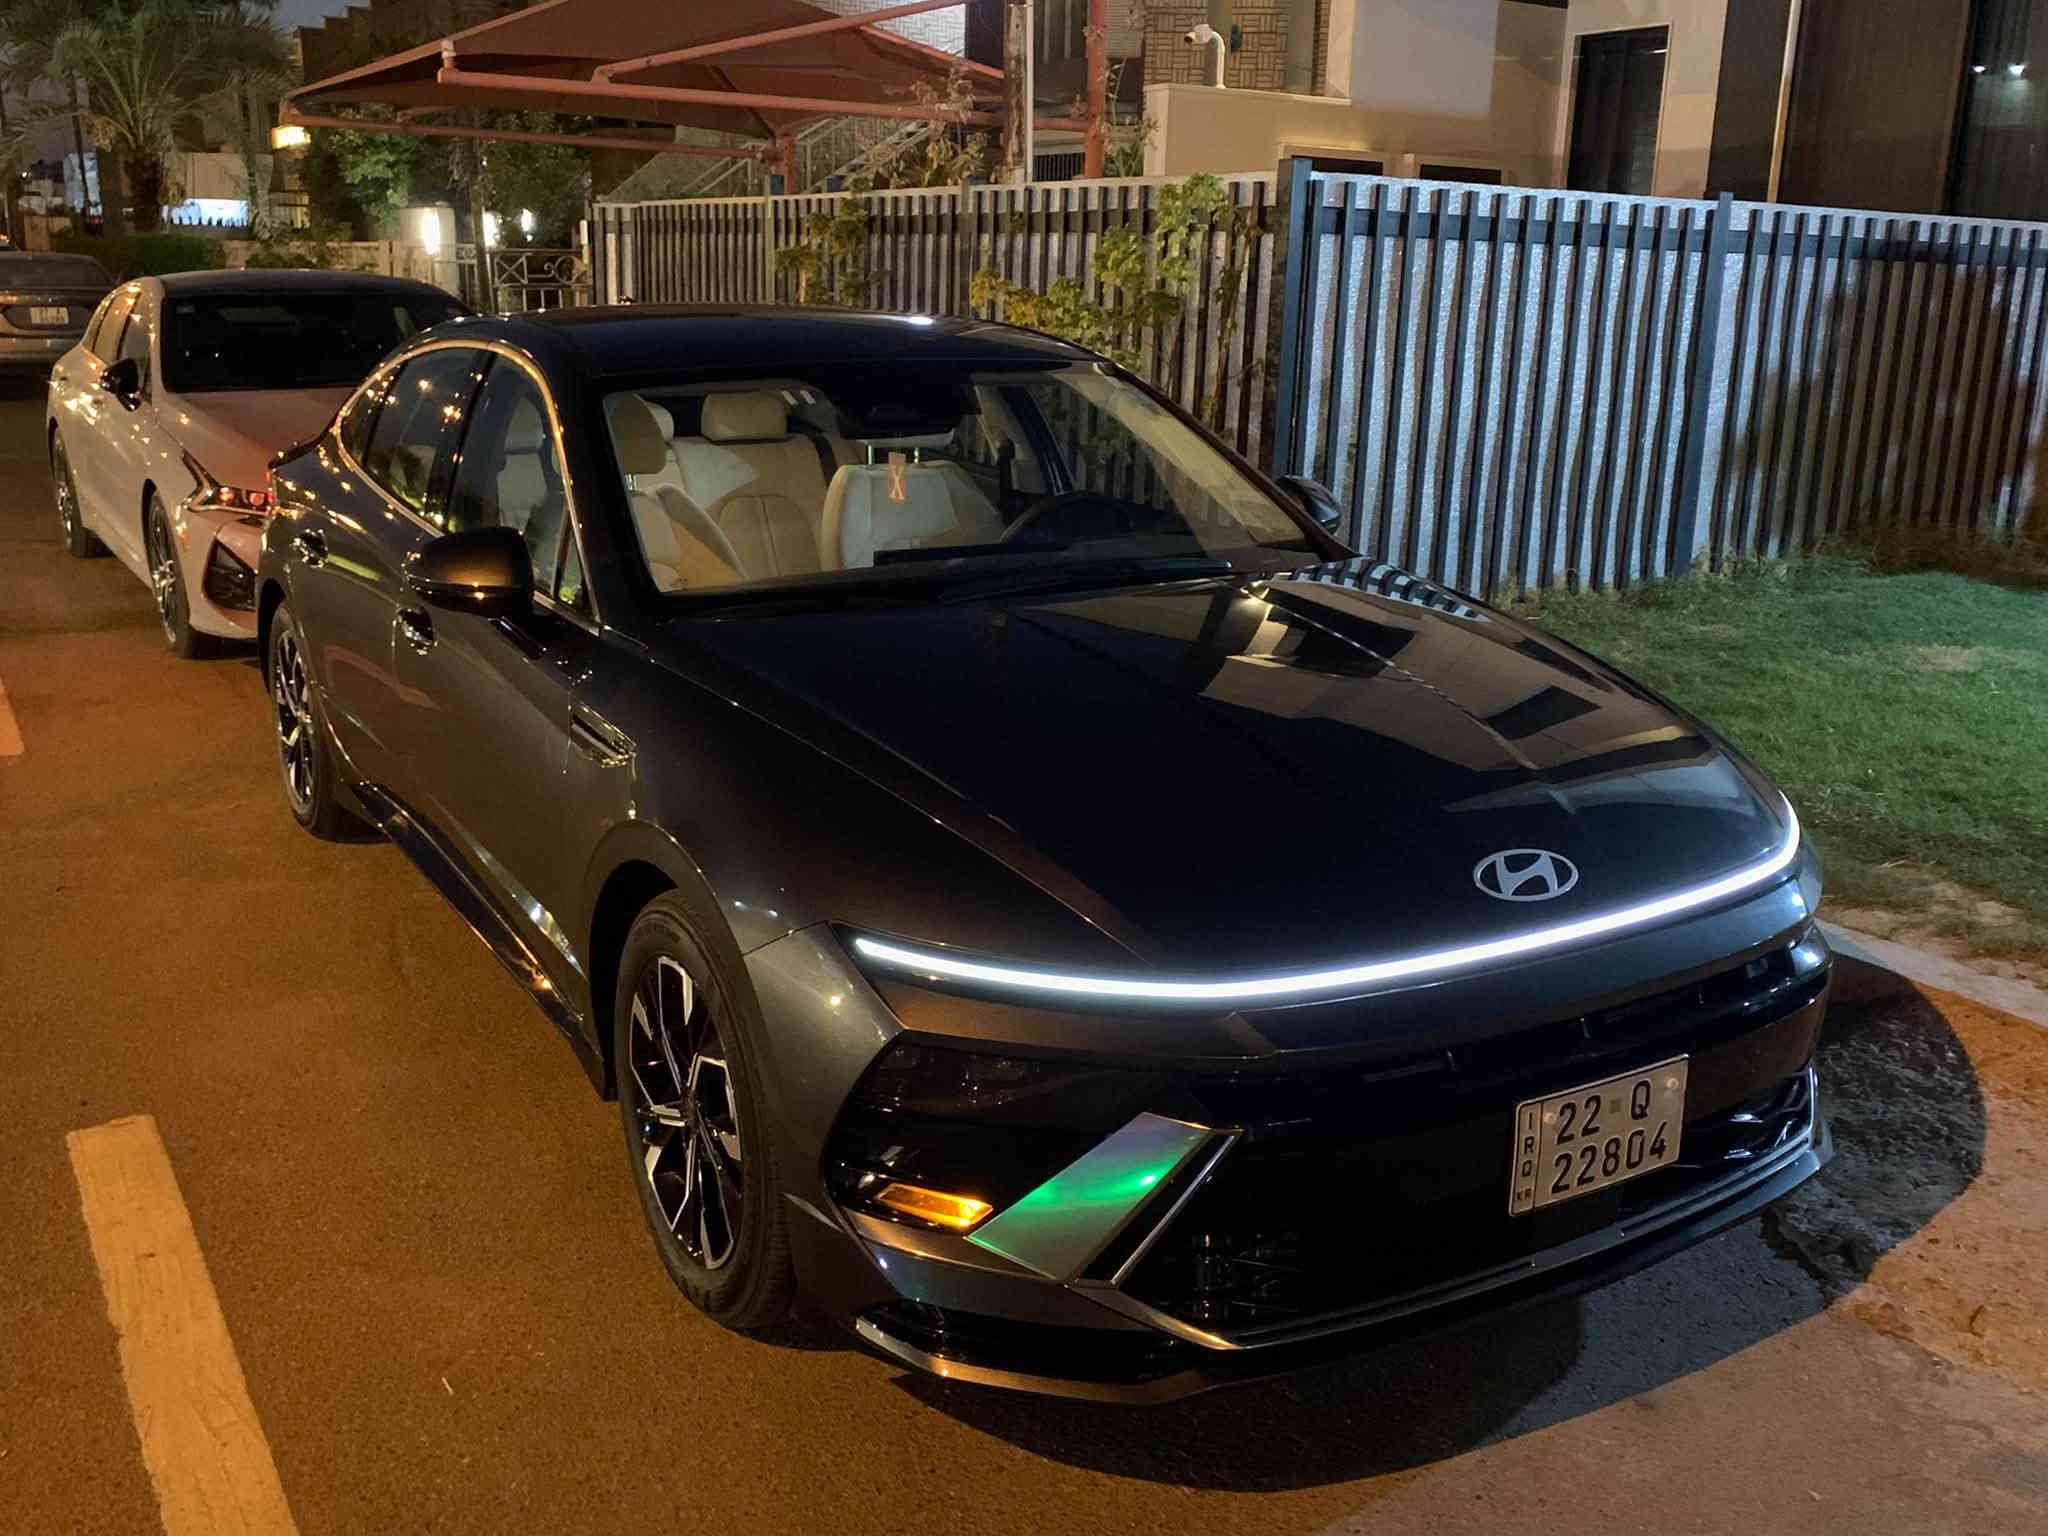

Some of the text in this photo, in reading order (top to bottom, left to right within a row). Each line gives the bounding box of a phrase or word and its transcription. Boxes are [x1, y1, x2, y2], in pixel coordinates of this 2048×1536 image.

[1557, 1080, 1651, 1144] 22 Q
[1551, 1121, 1668, 1194] 22804
